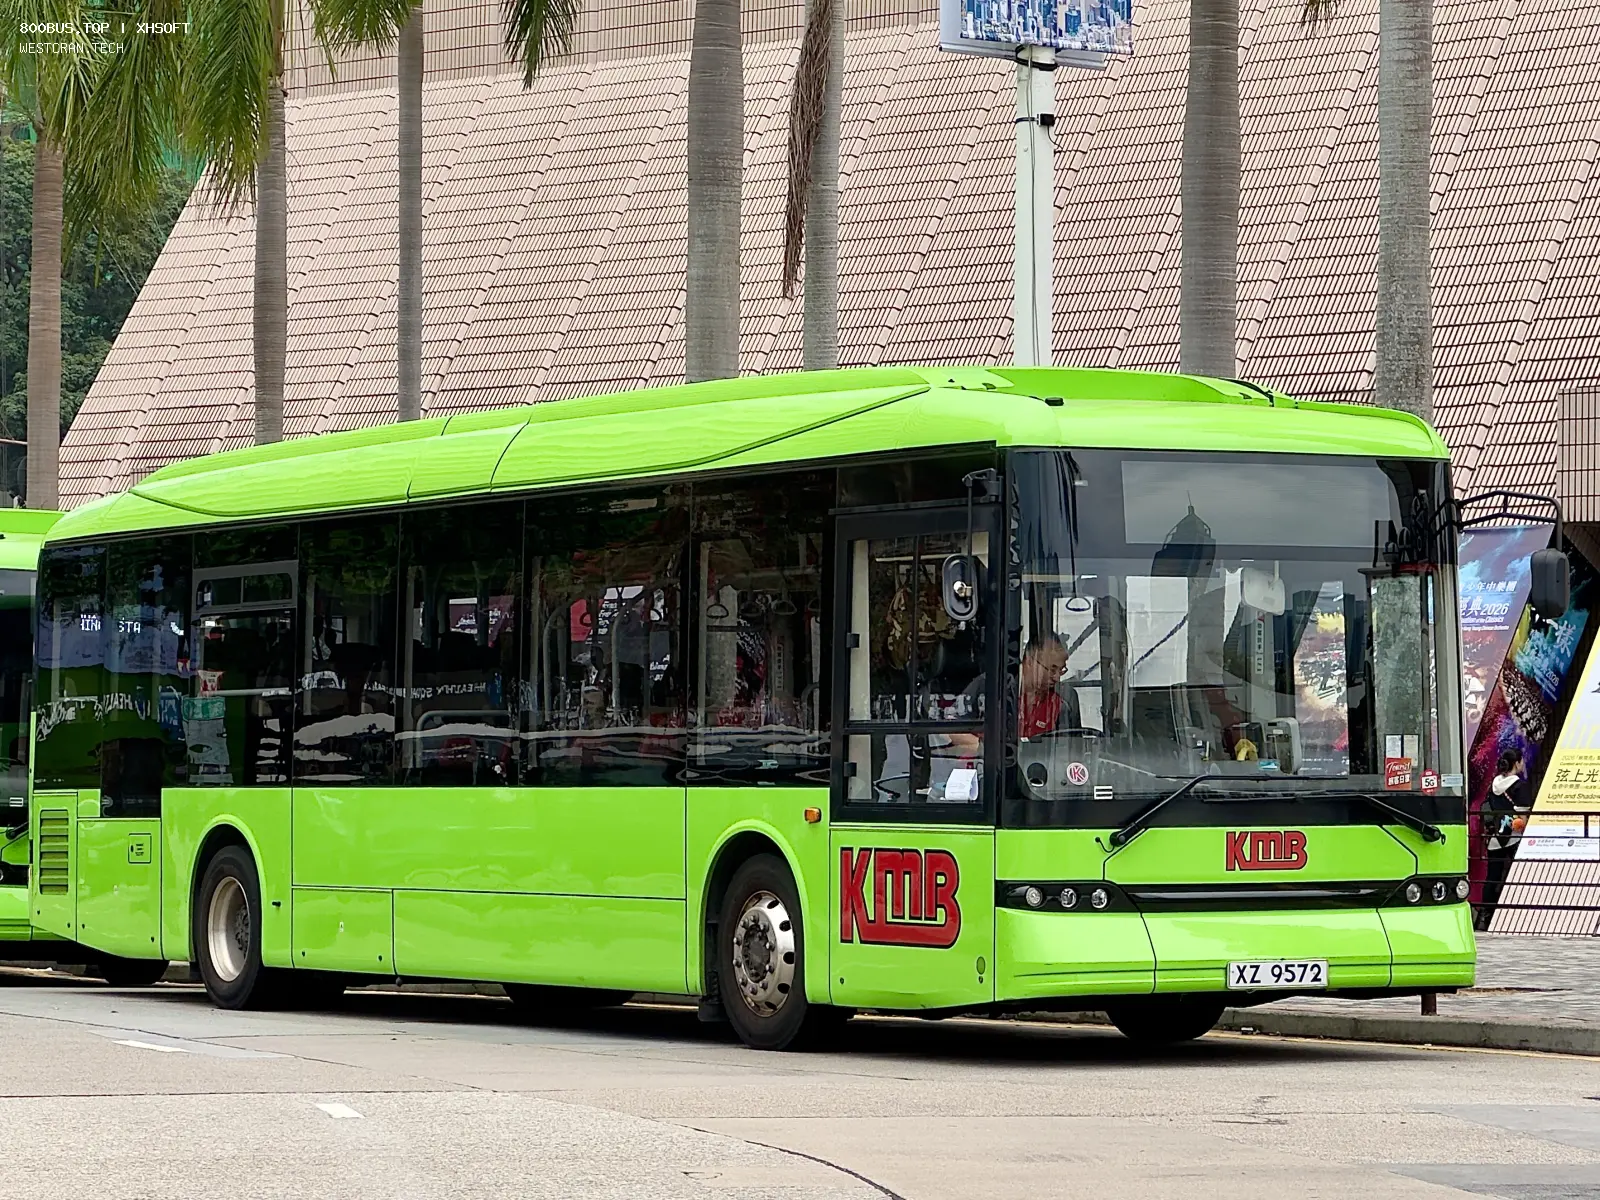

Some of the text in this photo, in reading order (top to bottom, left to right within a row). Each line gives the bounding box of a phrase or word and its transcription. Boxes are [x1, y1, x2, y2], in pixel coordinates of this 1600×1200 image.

[1554, 768, 1600, 782] 弦上光
[1226, 831, 1308, 871] KMB
[840, 847, 962, 949] KMB
[1235, 963, 1322, 984] XZ 9572
